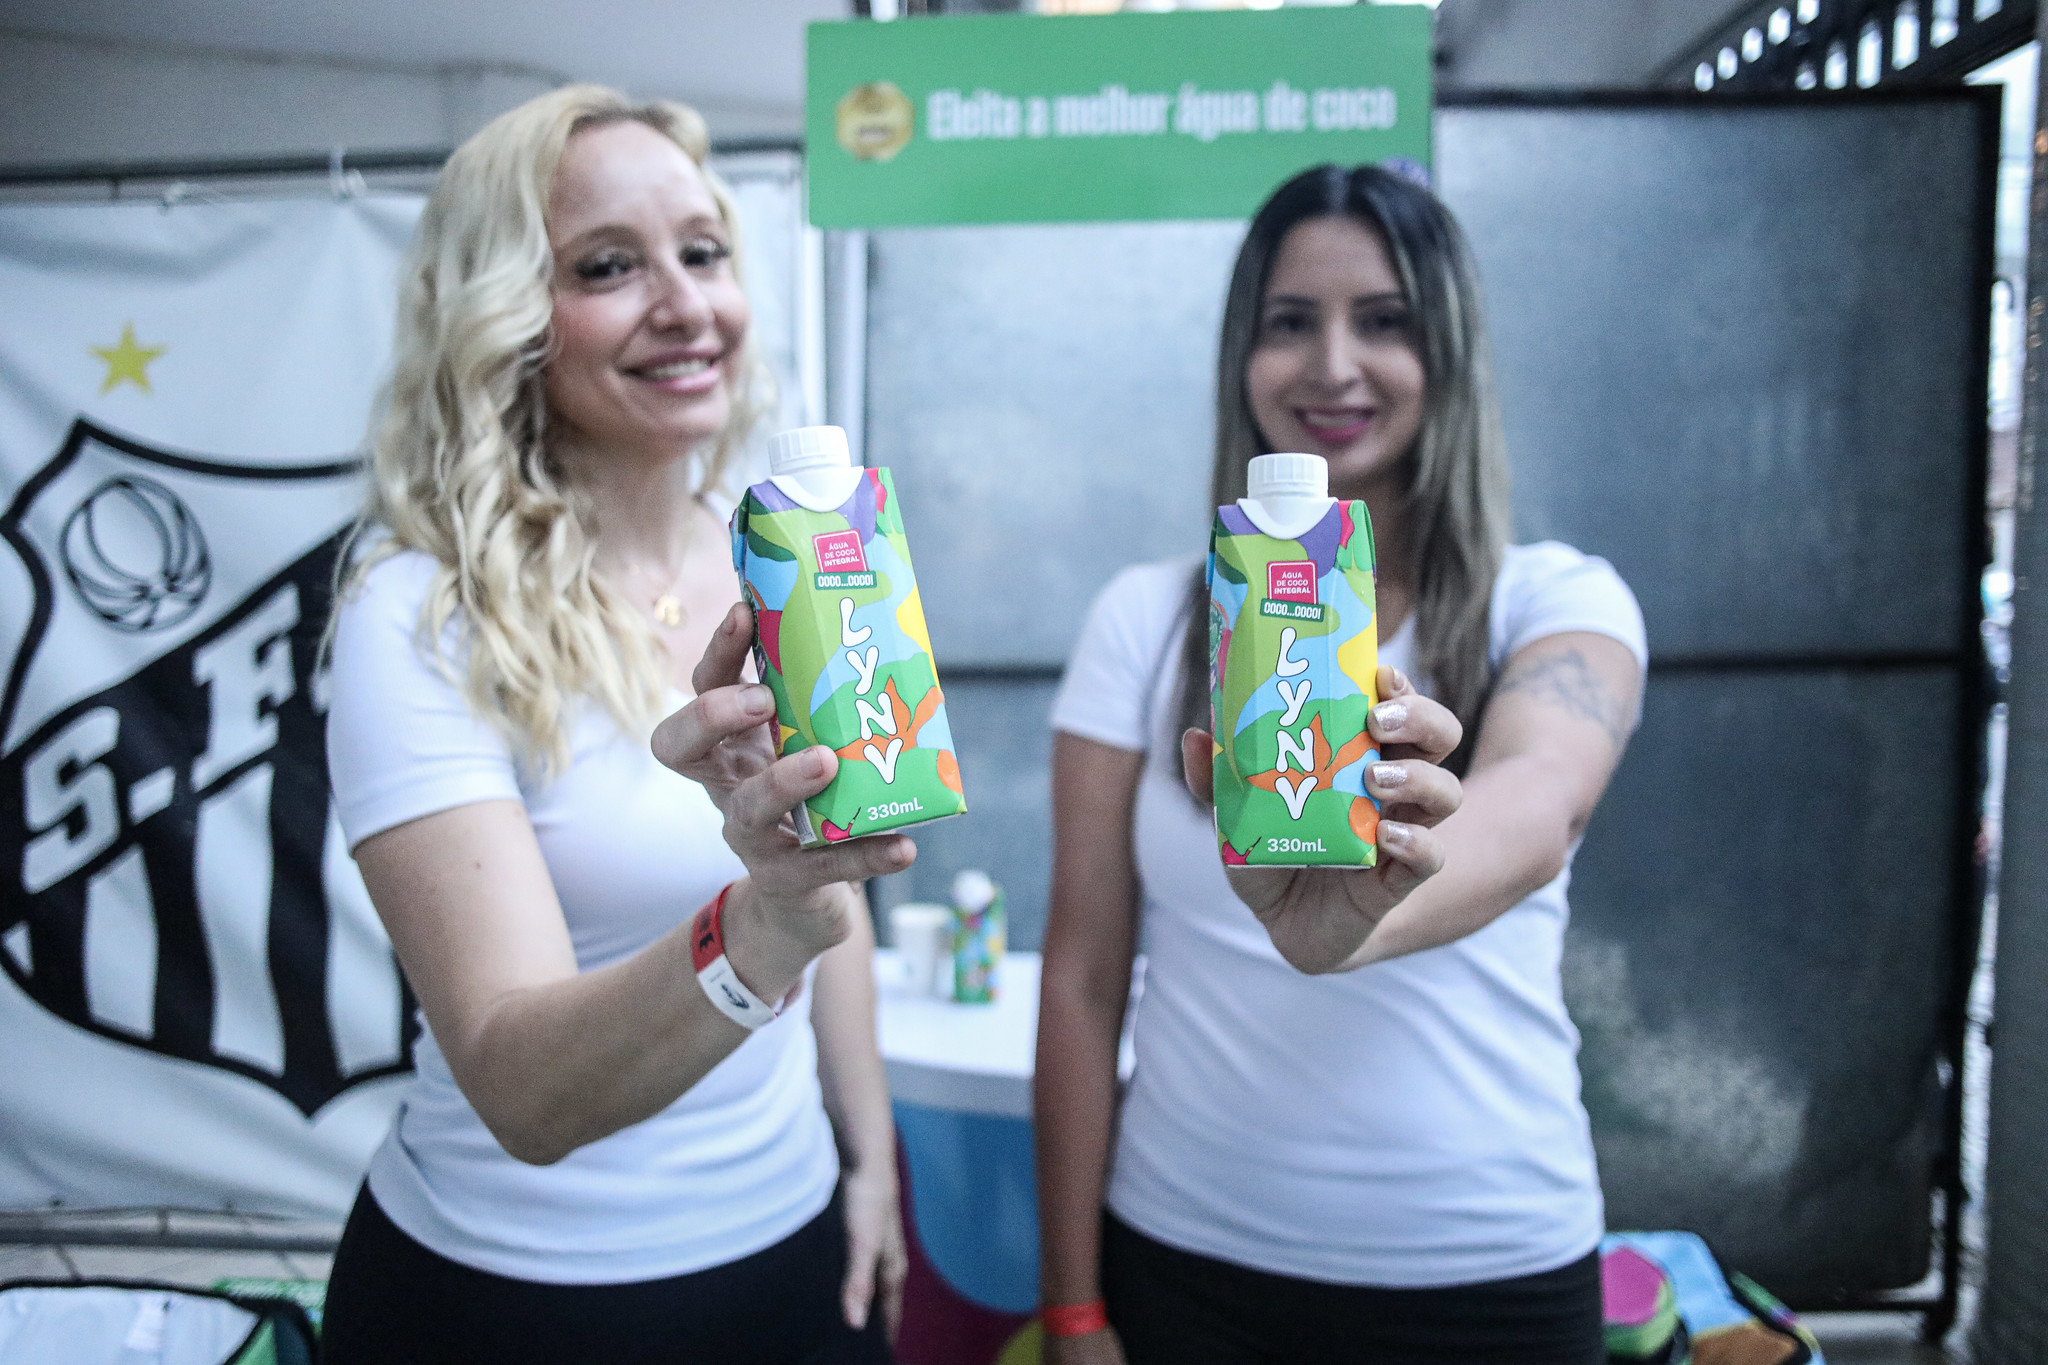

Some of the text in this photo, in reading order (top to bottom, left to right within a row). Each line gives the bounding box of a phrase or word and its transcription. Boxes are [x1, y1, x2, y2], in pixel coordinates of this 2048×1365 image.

[928, 80, 1397, 142] Eleita a melhor água de coco
[829, 541, 849, 551] ÁGUA
[824, 548, 856, 559] DE COCO
[824, 555, 860, 567] INTEGRAL
[1281, 571, 1303, 579] ÁGUA
[1287, 579, 1309, 587] COCO
[1274, 587, 1312, 595] INTEGRAL
[839, 597, 904, 785] LYNV
[1274, 626, 1319, 821] LYNV
[867, 797, 924, 822] 330mL
[1267, 838, 1327, 853] 330mL
